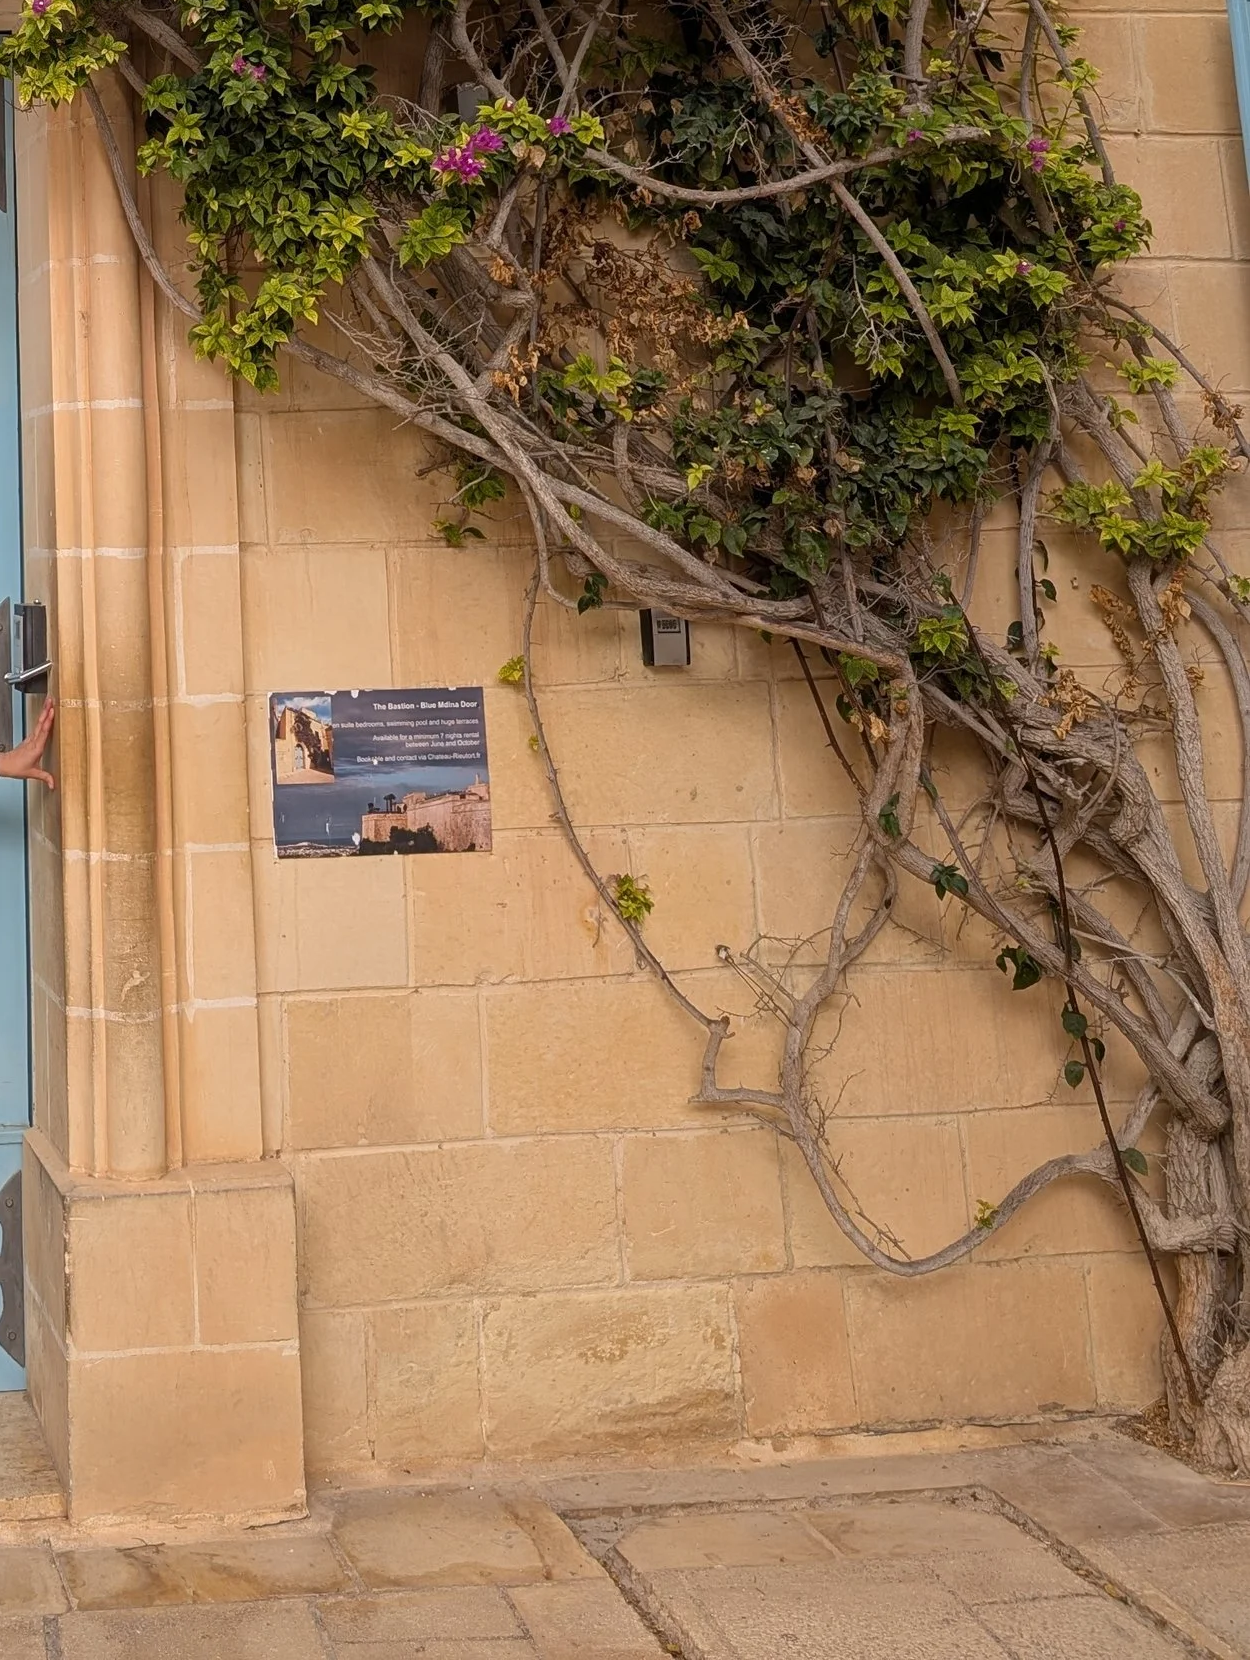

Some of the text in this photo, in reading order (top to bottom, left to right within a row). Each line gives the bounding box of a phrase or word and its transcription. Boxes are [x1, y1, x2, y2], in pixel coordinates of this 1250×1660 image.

[373, 703, 387, 711] The
[387, 702, 415, 710] Bastion
[420, 701, 436, 709] Blue
[437, 701, 459, 709] Mdina
[460, 700, 478, 708] Door
[386, 720, 415, 728] swimming
[415, 719, 428, 727] pool
[440, 719, 455, 727] huge
[445, 732, 462, 740] nights
